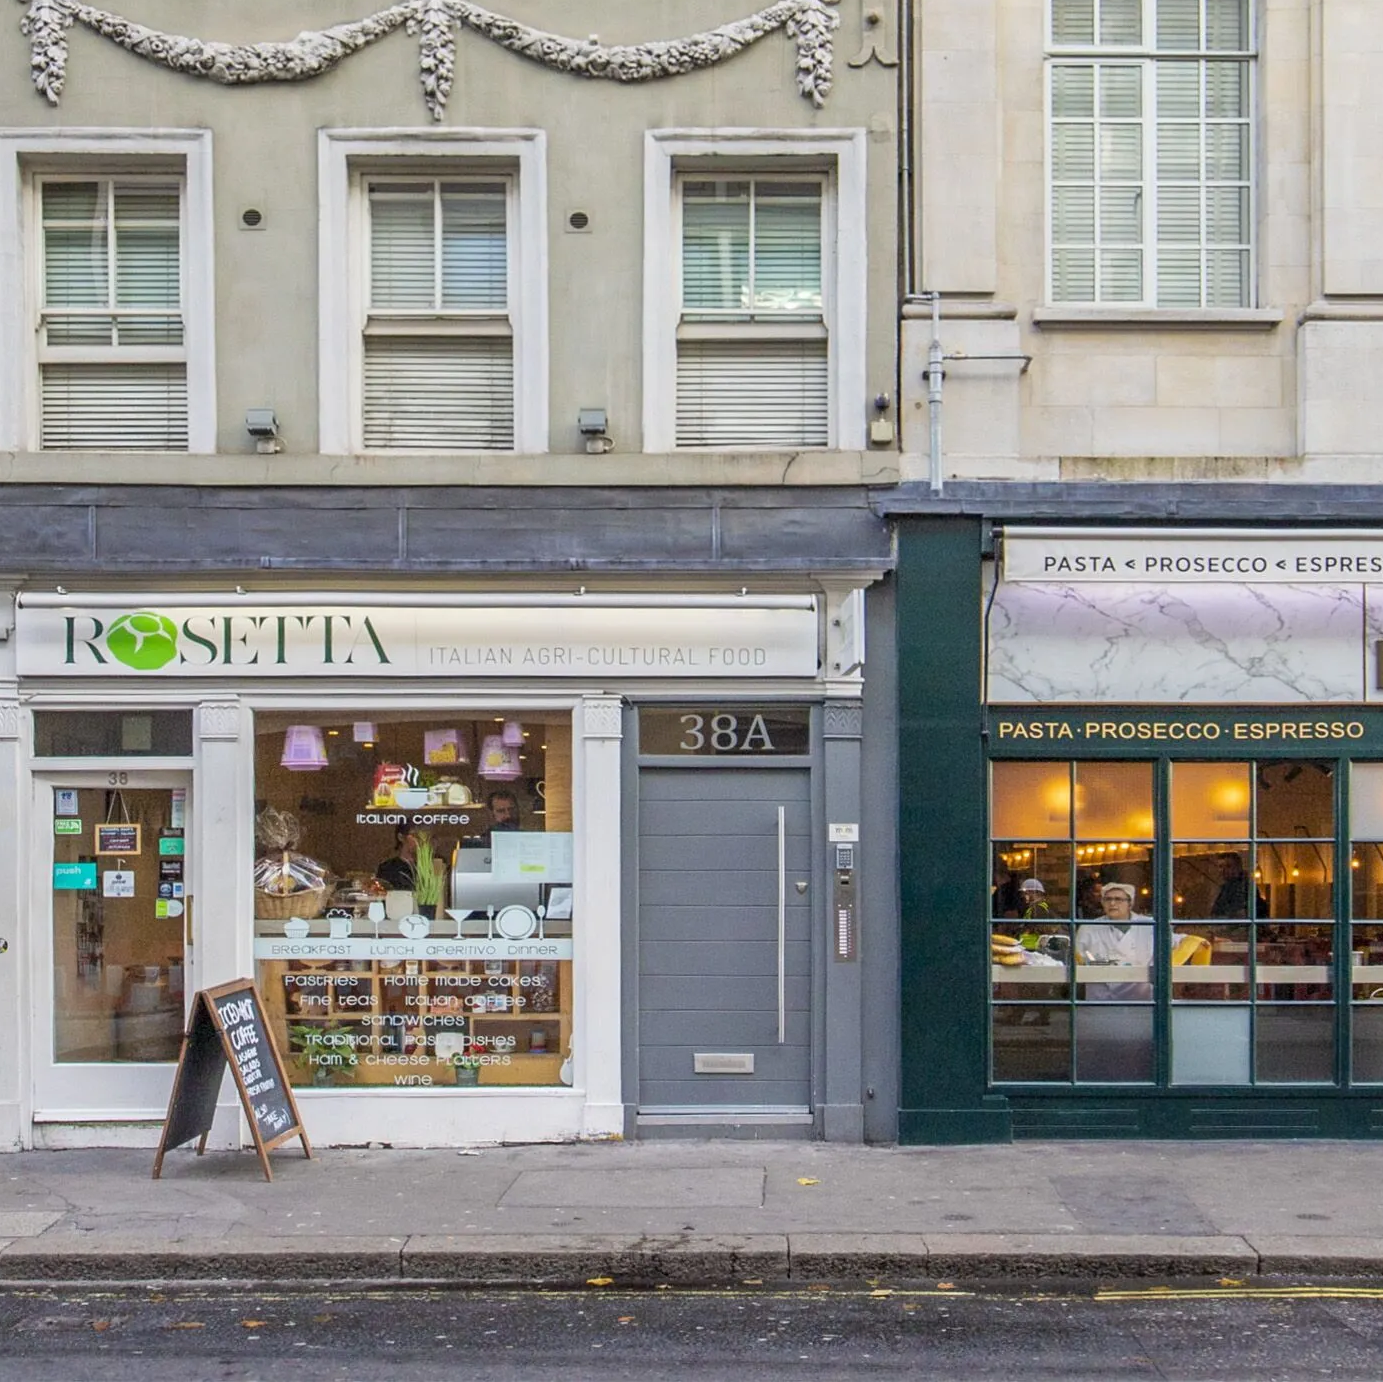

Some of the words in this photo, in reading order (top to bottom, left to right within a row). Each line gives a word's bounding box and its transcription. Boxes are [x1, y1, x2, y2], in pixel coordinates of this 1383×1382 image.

[1044, 556, 1116, 573] PASTA
[1144, 556, 1268, 574] PROSECCO
[429, 647, 513, 665] ITALIAN
[522, 647, 699, 666] AGRI-CULTURAL
[709, 647, 767, 666] FOOD
[679, 714, 776, 751] 38A
[999, 723, 1074, 739] PASTA
[1085, 723, 1220, 739] PROSECCO
[1234, 723, 1365, 739] ESPRESSO
[108, 771, 129, 785] 38
[55, 865, 82, 876] push
[231, 1024, 259, 1050] COFFEE
[348, 1055, 358, 1065] &
